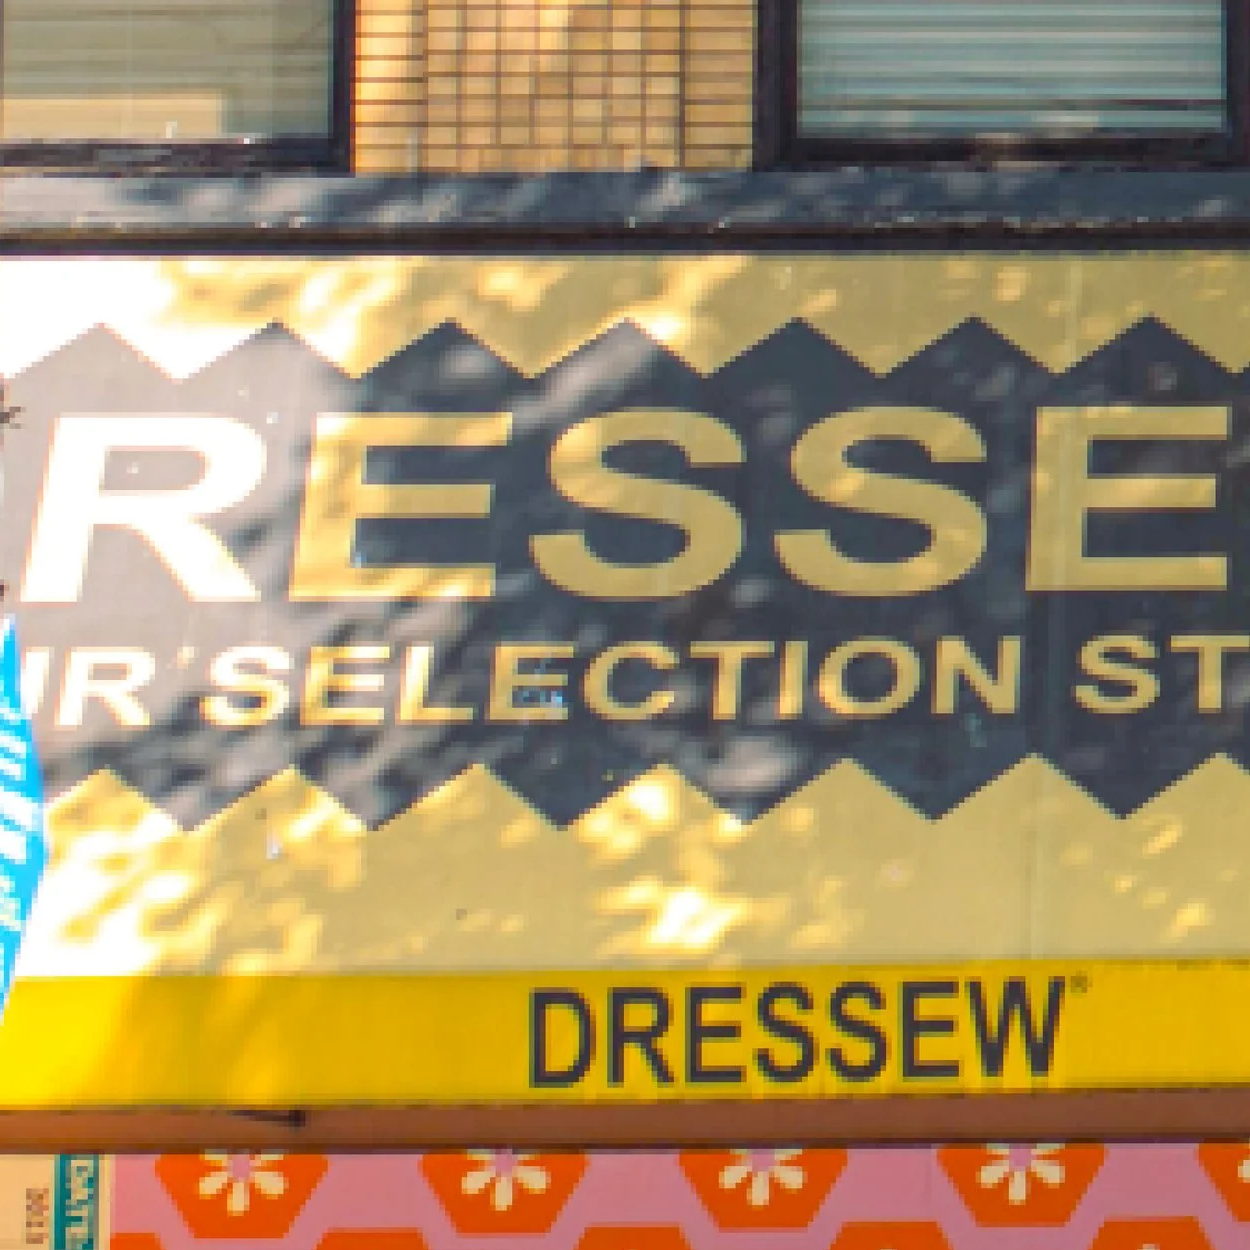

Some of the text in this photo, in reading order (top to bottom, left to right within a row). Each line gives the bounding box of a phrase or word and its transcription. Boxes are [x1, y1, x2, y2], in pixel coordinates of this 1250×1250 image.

[203, 634, 1021, 726] SELECTION
[1071, 634, 1250, 715] ST
[529, 975, 1066, 1089] DRESSEW
